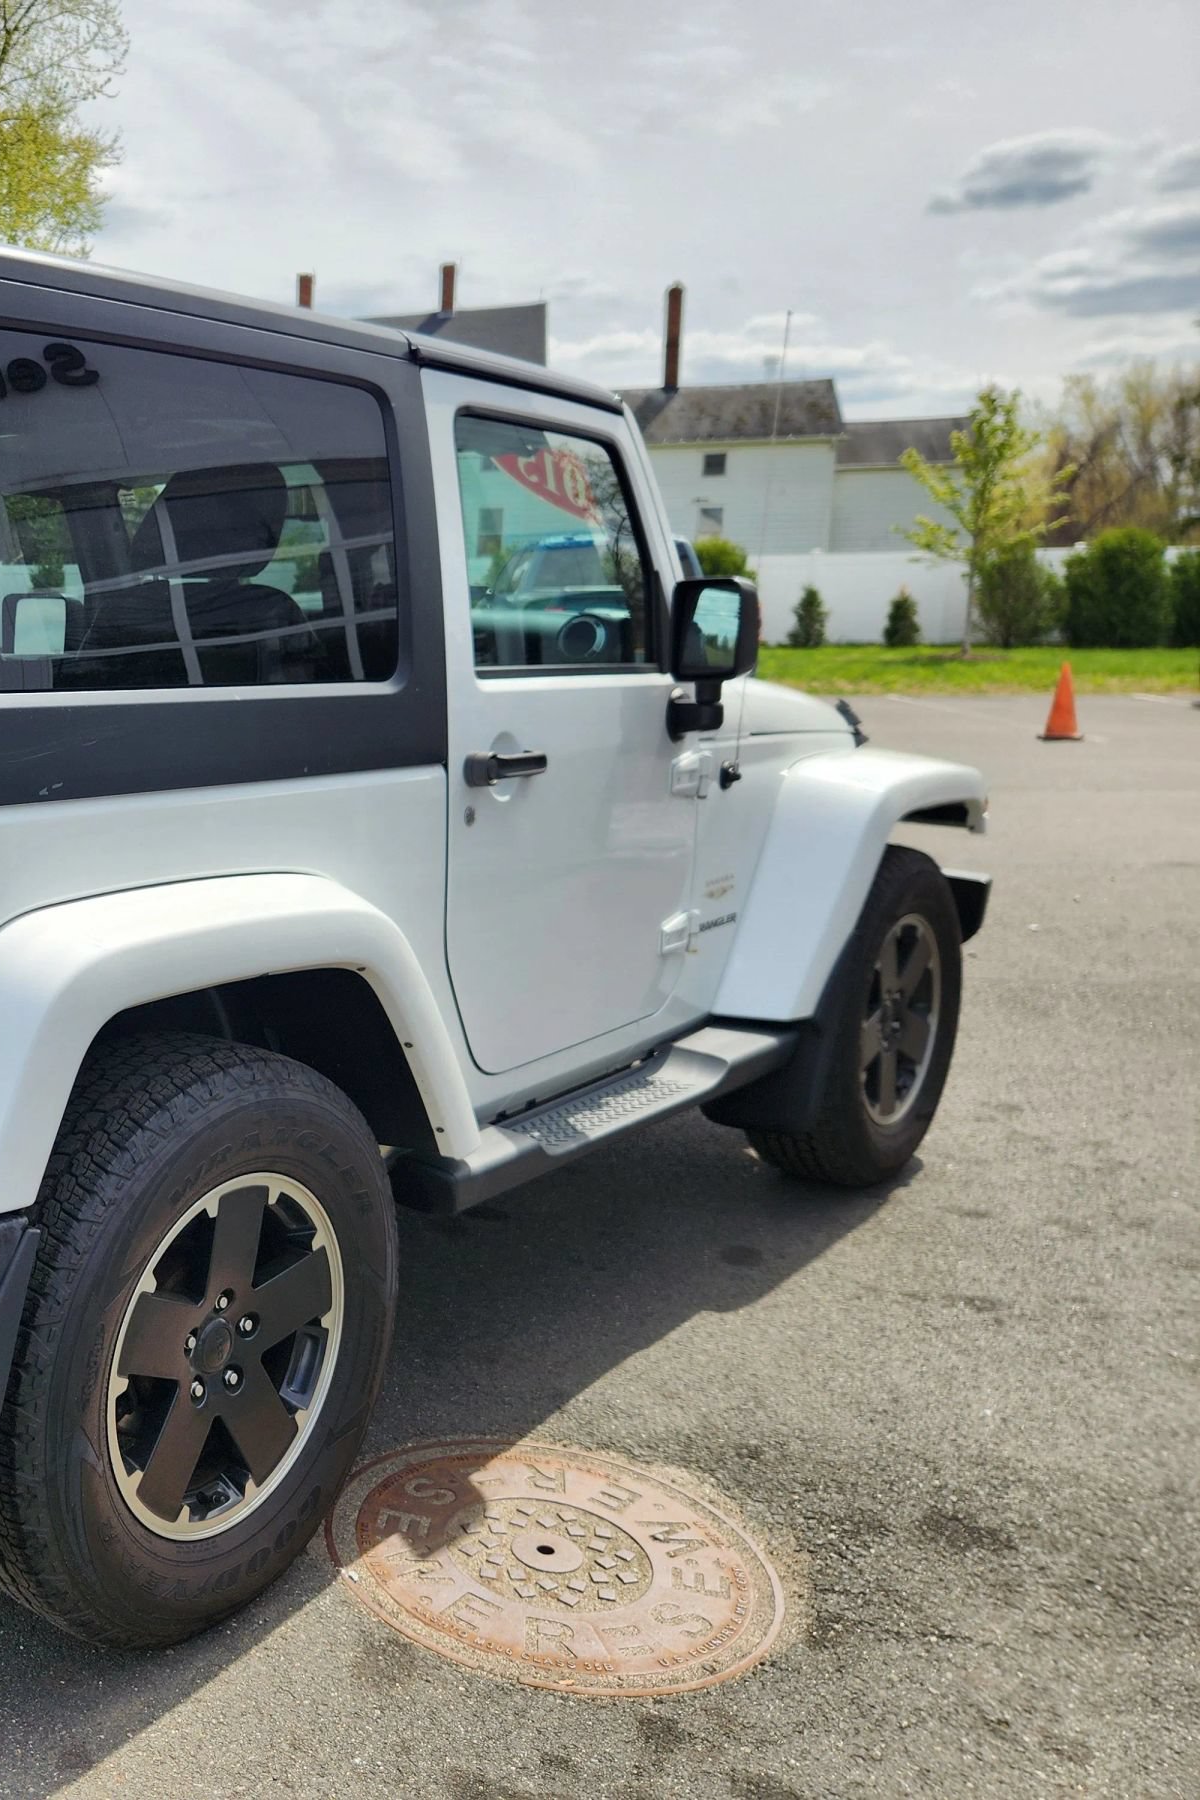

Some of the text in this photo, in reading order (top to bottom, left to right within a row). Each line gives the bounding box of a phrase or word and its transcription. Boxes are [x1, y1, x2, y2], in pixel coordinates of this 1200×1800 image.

[519, 1651, 576, 1669] CLASS
[582, 1661, 616, 1671] 35B
[654, 1652, 690, 1667] U.S.
[685, 1623, 742, 1658] FOUNDRY
